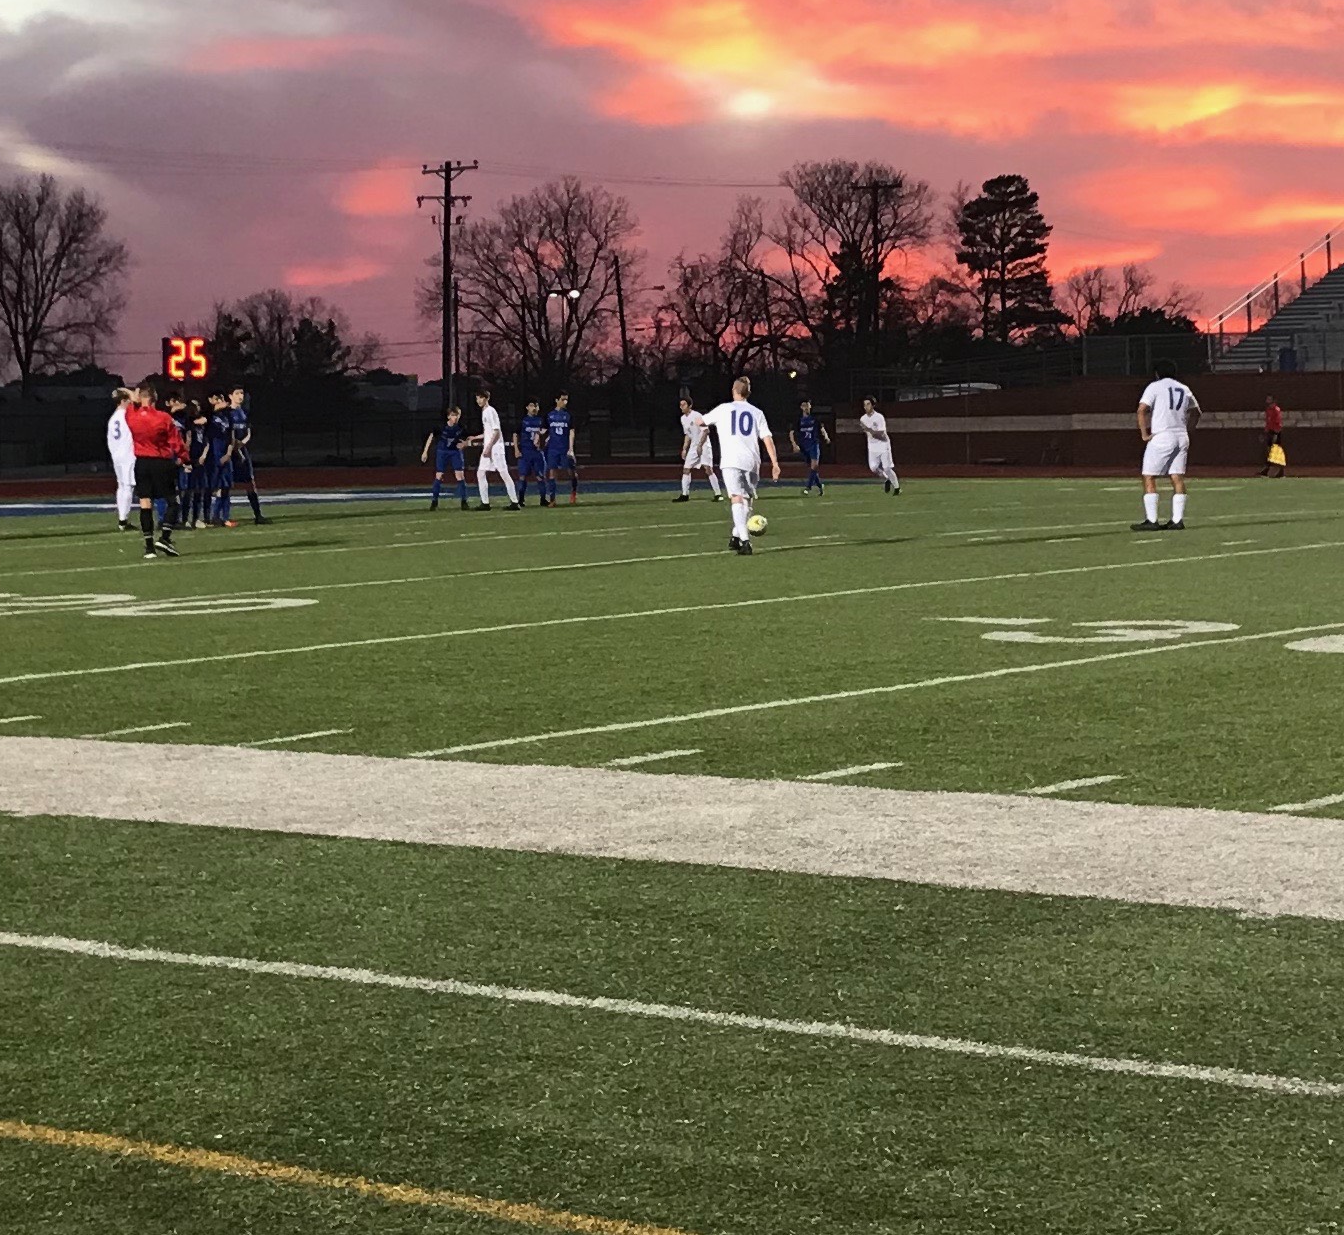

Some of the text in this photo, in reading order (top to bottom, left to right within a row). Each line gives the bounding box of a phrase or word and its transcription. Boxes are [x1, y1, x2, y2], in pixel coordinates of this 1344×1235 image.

[168, 337, 208, 379] 25
[1168, 386, 1185, 411] 17
[730, 410, 754, 436] 10
